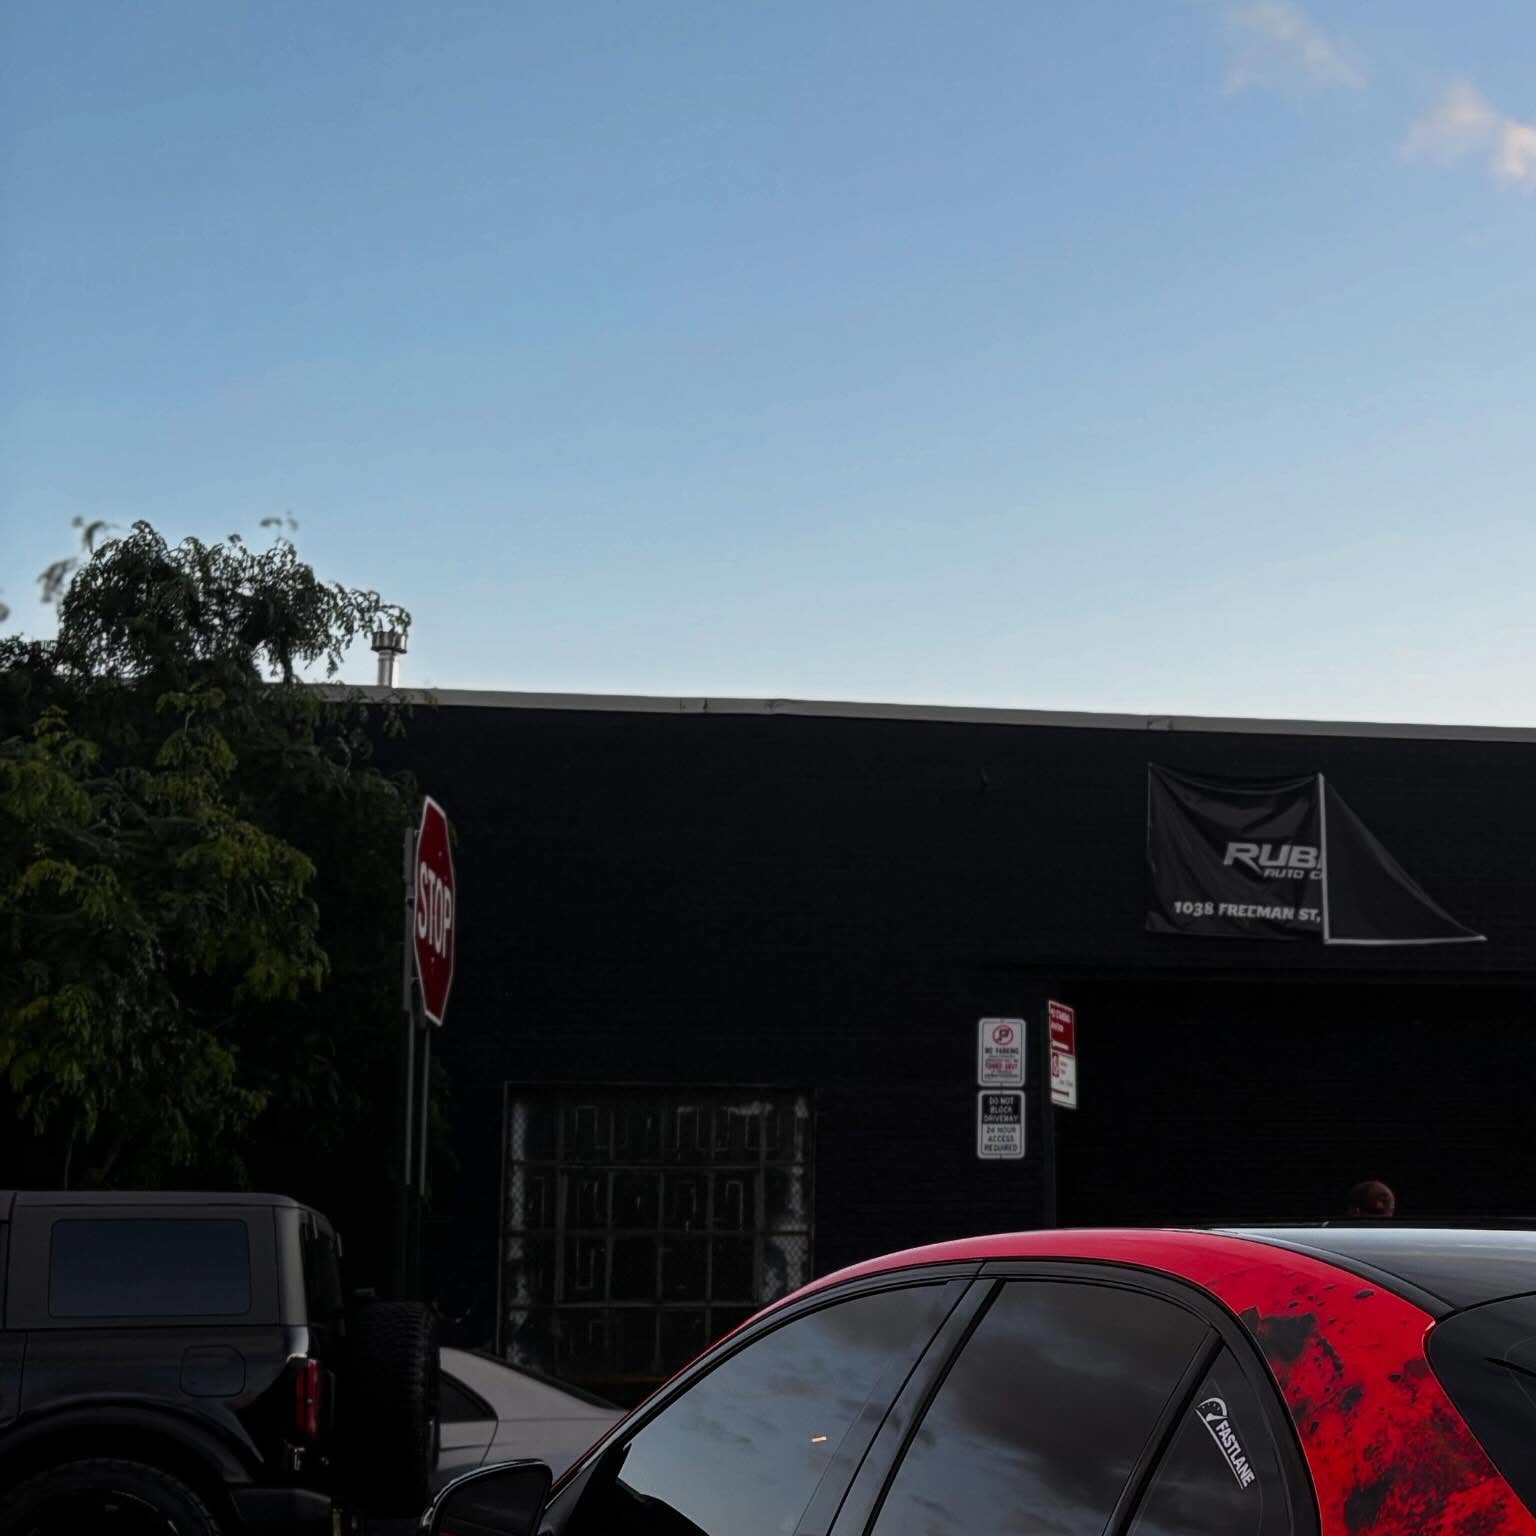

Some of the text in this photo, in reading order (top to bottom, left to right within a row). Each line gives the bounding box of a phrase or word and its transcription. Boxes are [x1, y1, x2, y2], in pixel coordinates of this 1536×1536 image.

[1223, 841, 1322, 874] RUB
[1263, 868, 1304, 879] AUTO
[418, 861, 451, 959] STOP
[1173, 901, 1215, 917] 1038
[1218, 903, 1294, 920] FREEMAN
[1000, 1096, 1014, 1104] NOT
[990, 1105, 1013, 1113] BLOCK
[984, 1114, 1019, 1122] DRIVEWAY
[1215, 1420, 1256, 1488] FASTLANE
